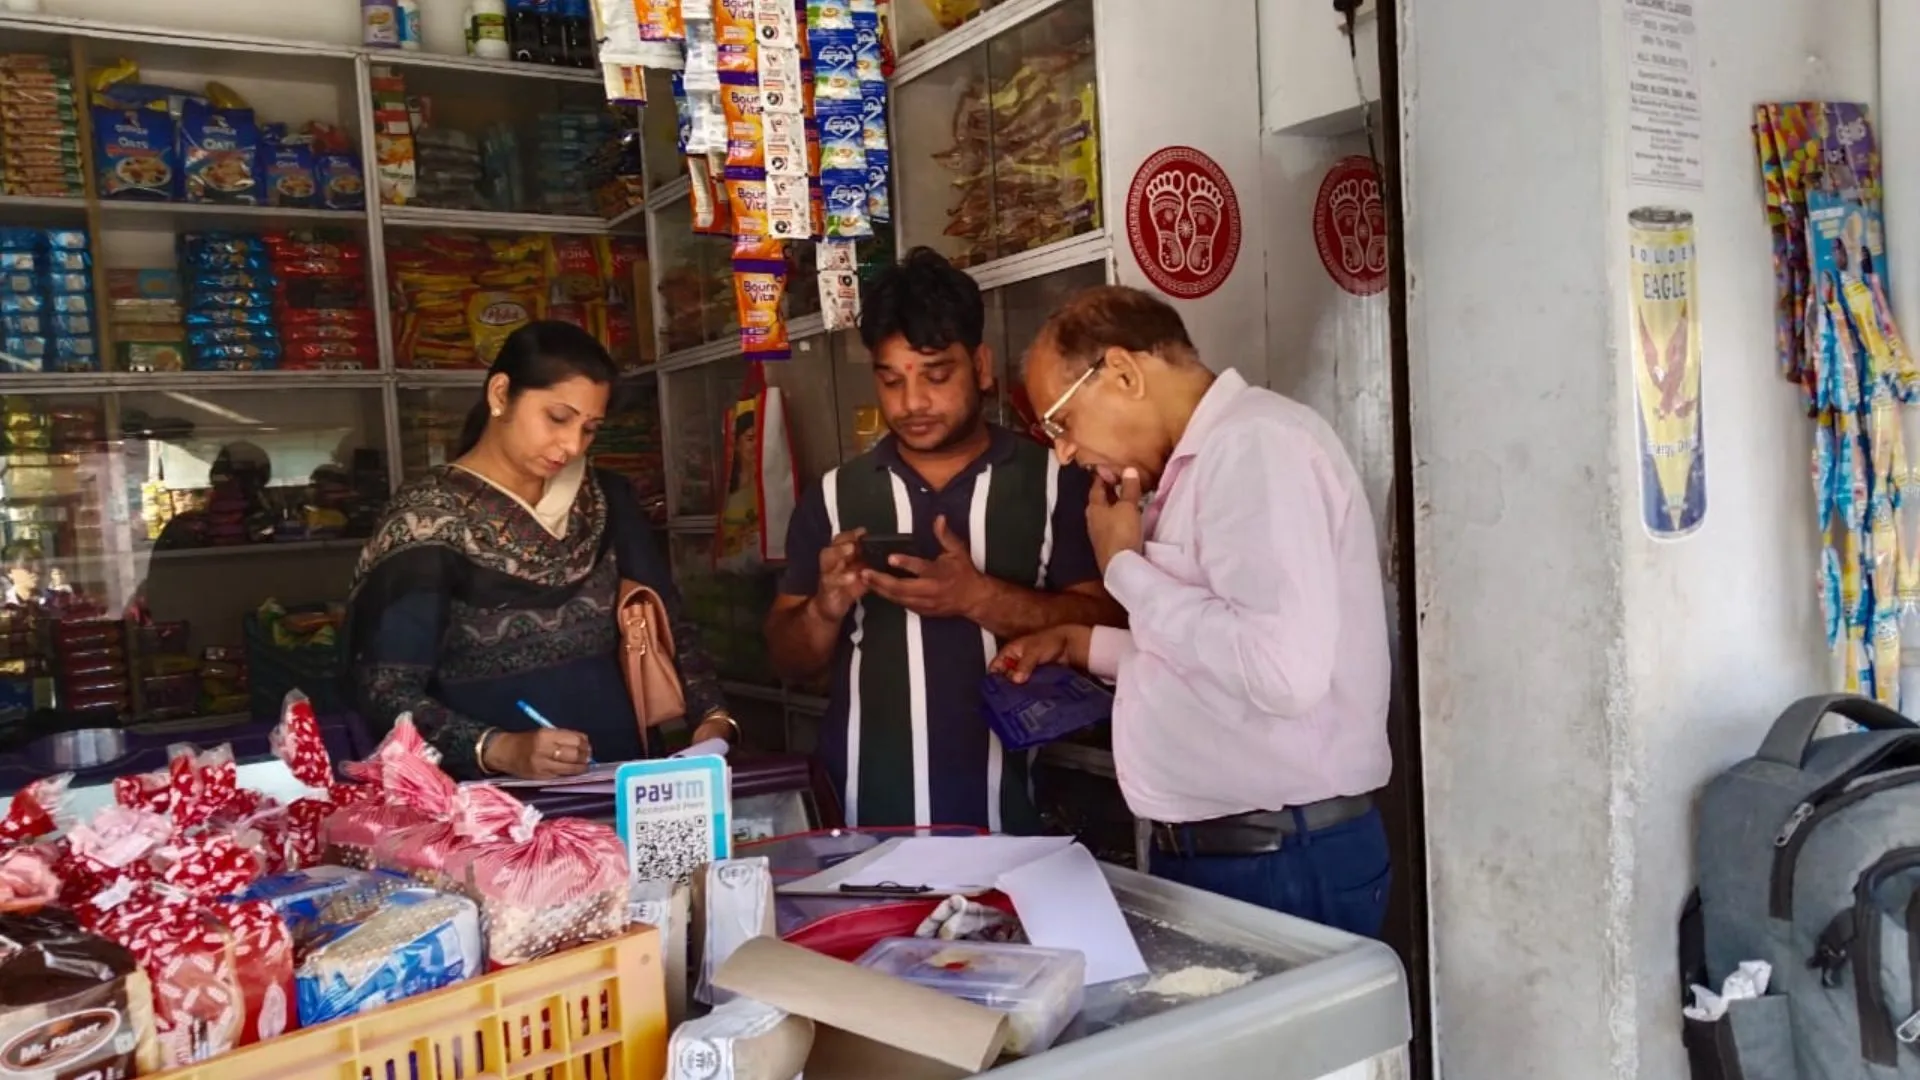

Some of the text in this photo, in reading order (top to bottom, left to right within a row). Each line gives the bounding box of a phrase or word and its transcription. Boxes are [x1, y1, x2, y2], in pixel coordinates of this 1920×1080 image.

[737, 187, 767, 200] Bour
[744, 280, 779, 293] Bourn
[1643, 271, 1686, 300] EAGLE
[748, 291, 776, 304] Vita
